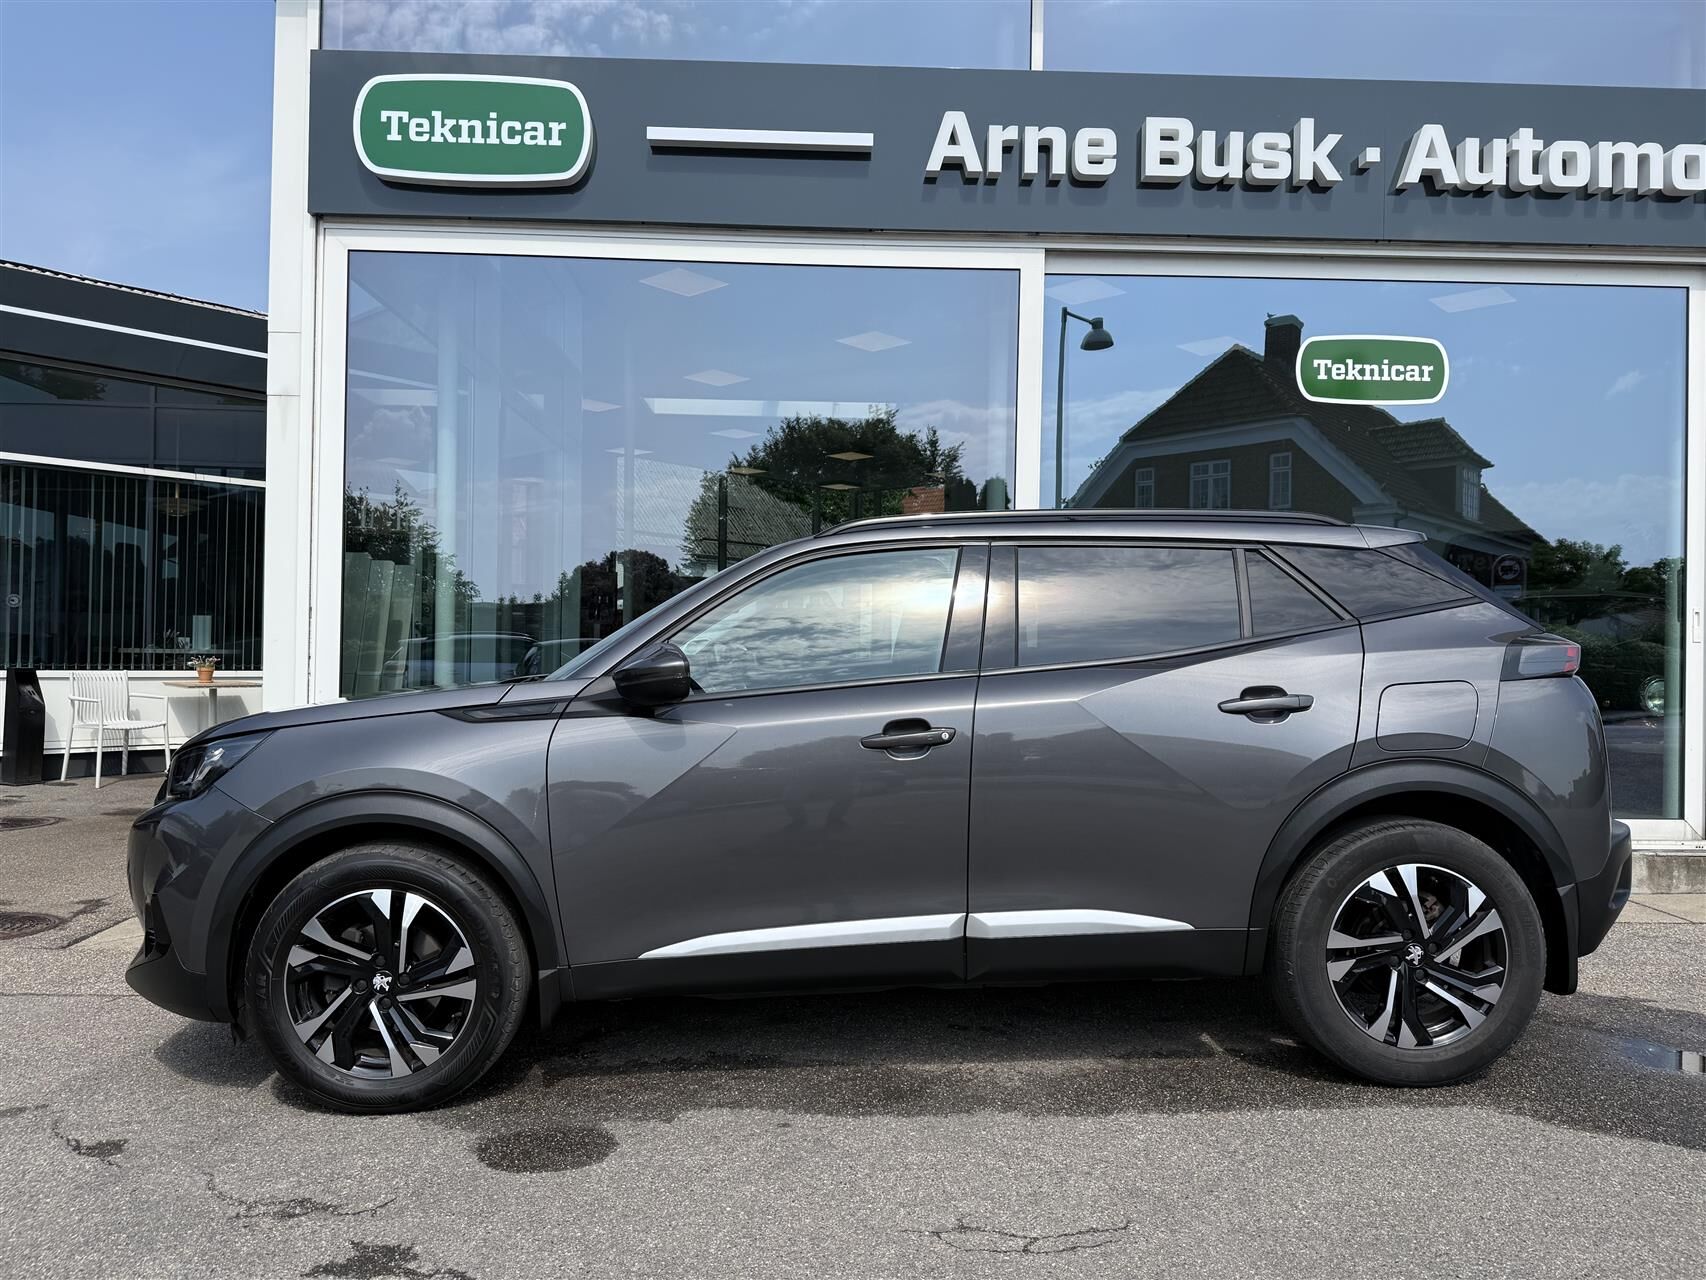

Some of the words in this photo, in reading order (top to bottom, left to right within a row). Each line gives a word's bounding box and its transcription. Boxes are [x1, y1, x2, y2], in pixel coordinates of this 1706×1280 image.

[380, 110, 567, 147] Teknicar
[926, 111, 1117, 178] Arne
[1142, 117, 1343, 181] Busk
[1398, 124, 1706, 192] Automo
[1313, 359, 1434, 382] Teknicar
